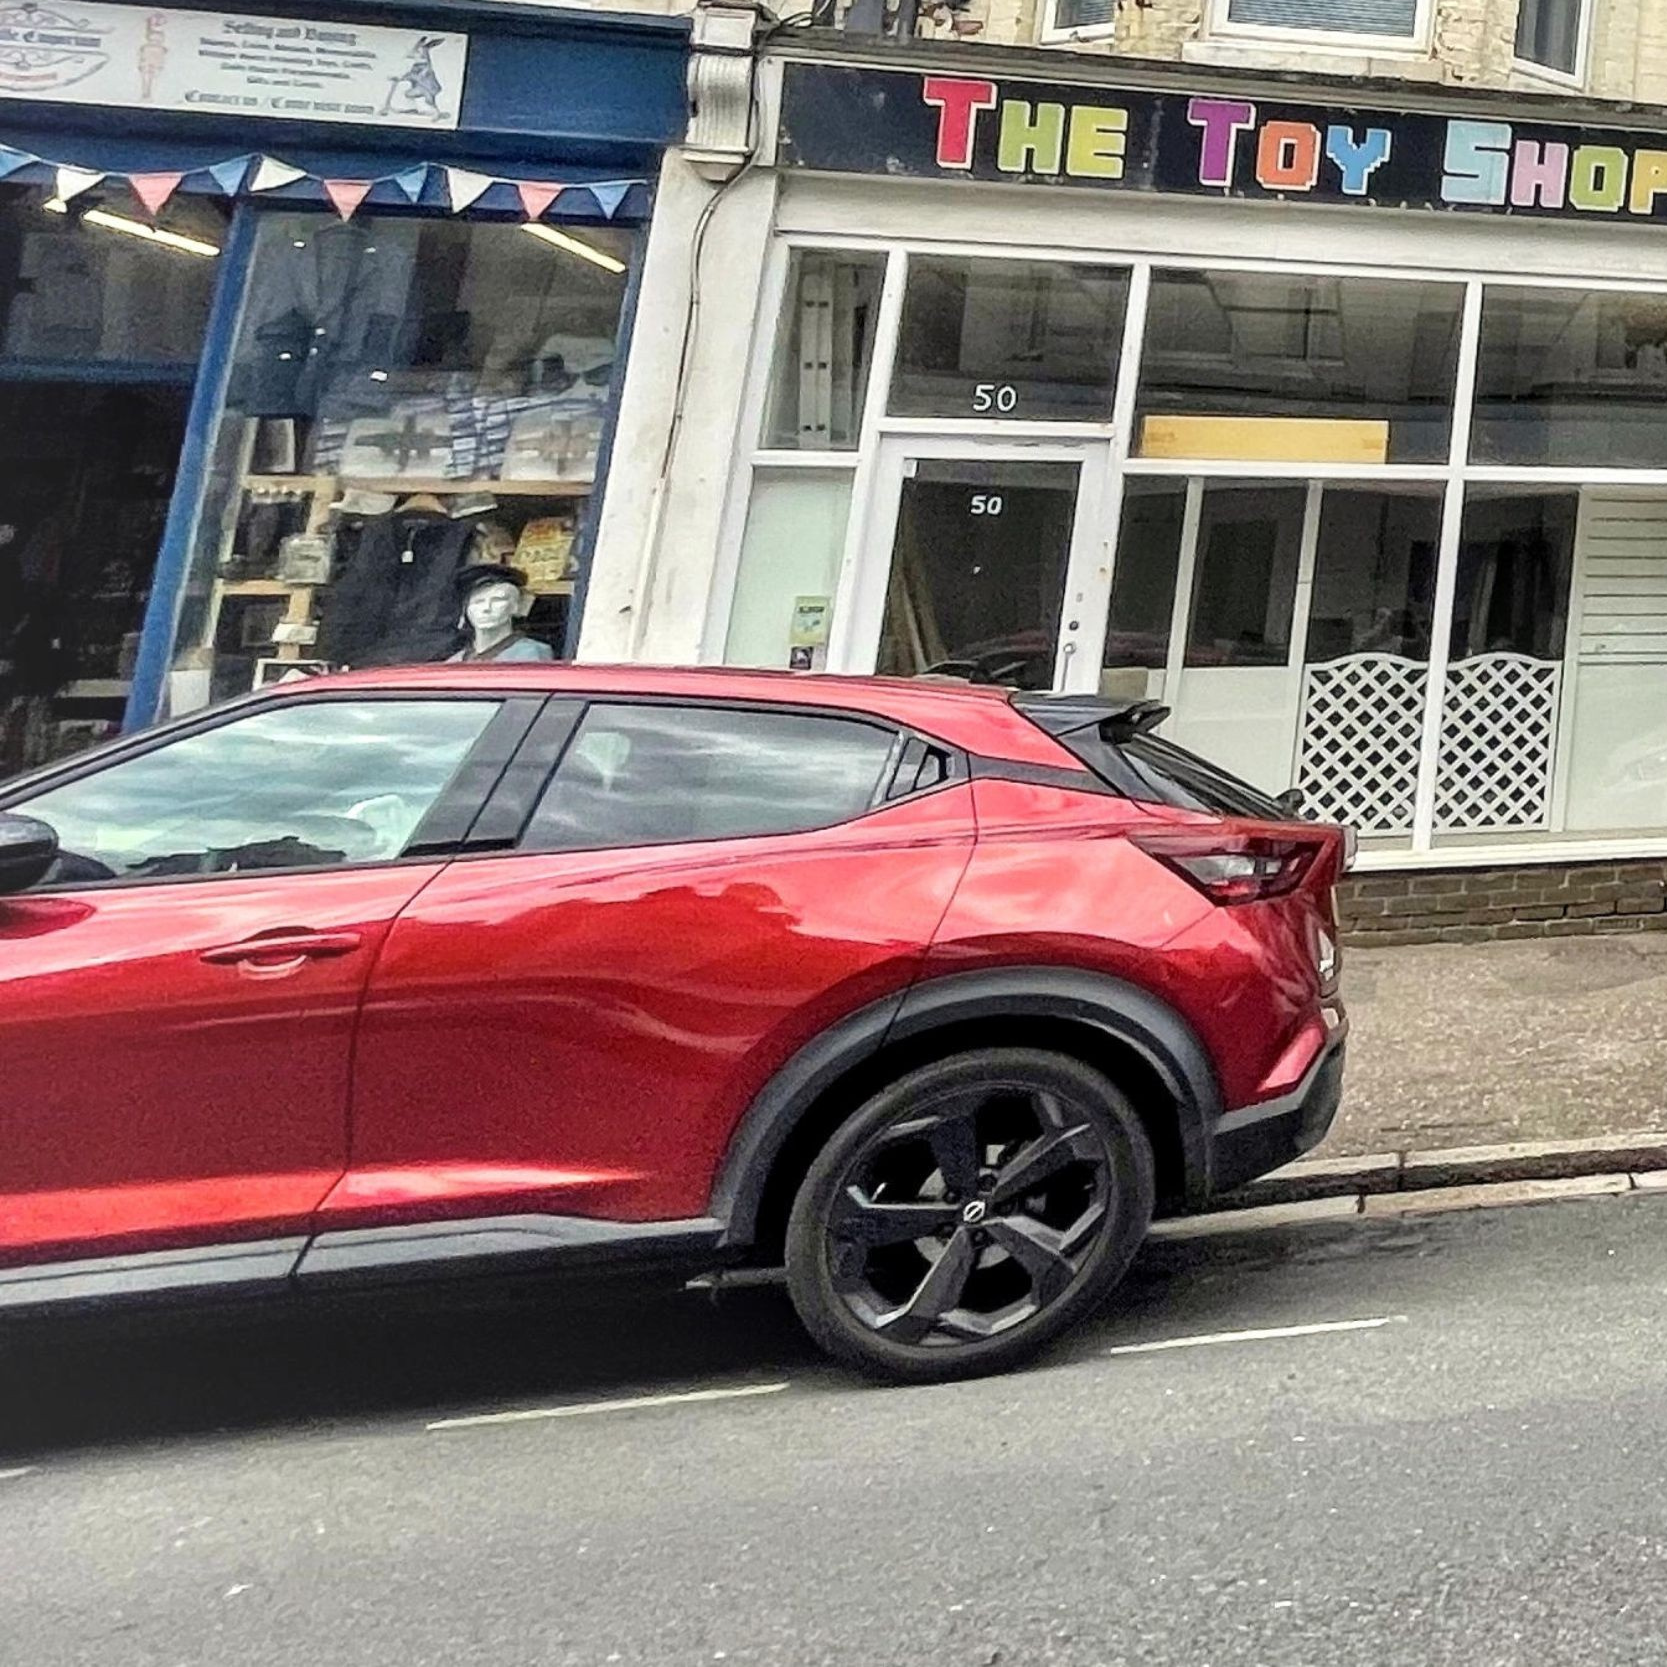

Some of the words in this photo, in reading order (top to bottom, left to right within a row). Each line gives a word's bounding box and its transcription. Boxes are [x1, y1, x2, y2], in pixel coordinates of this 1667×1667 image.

[923, 76, 1128, 179] THE
[1187, 97, 1392, 195] TOY
[972, 384, 1018, 412] 50
[970, 495, 1003, 516] 50
